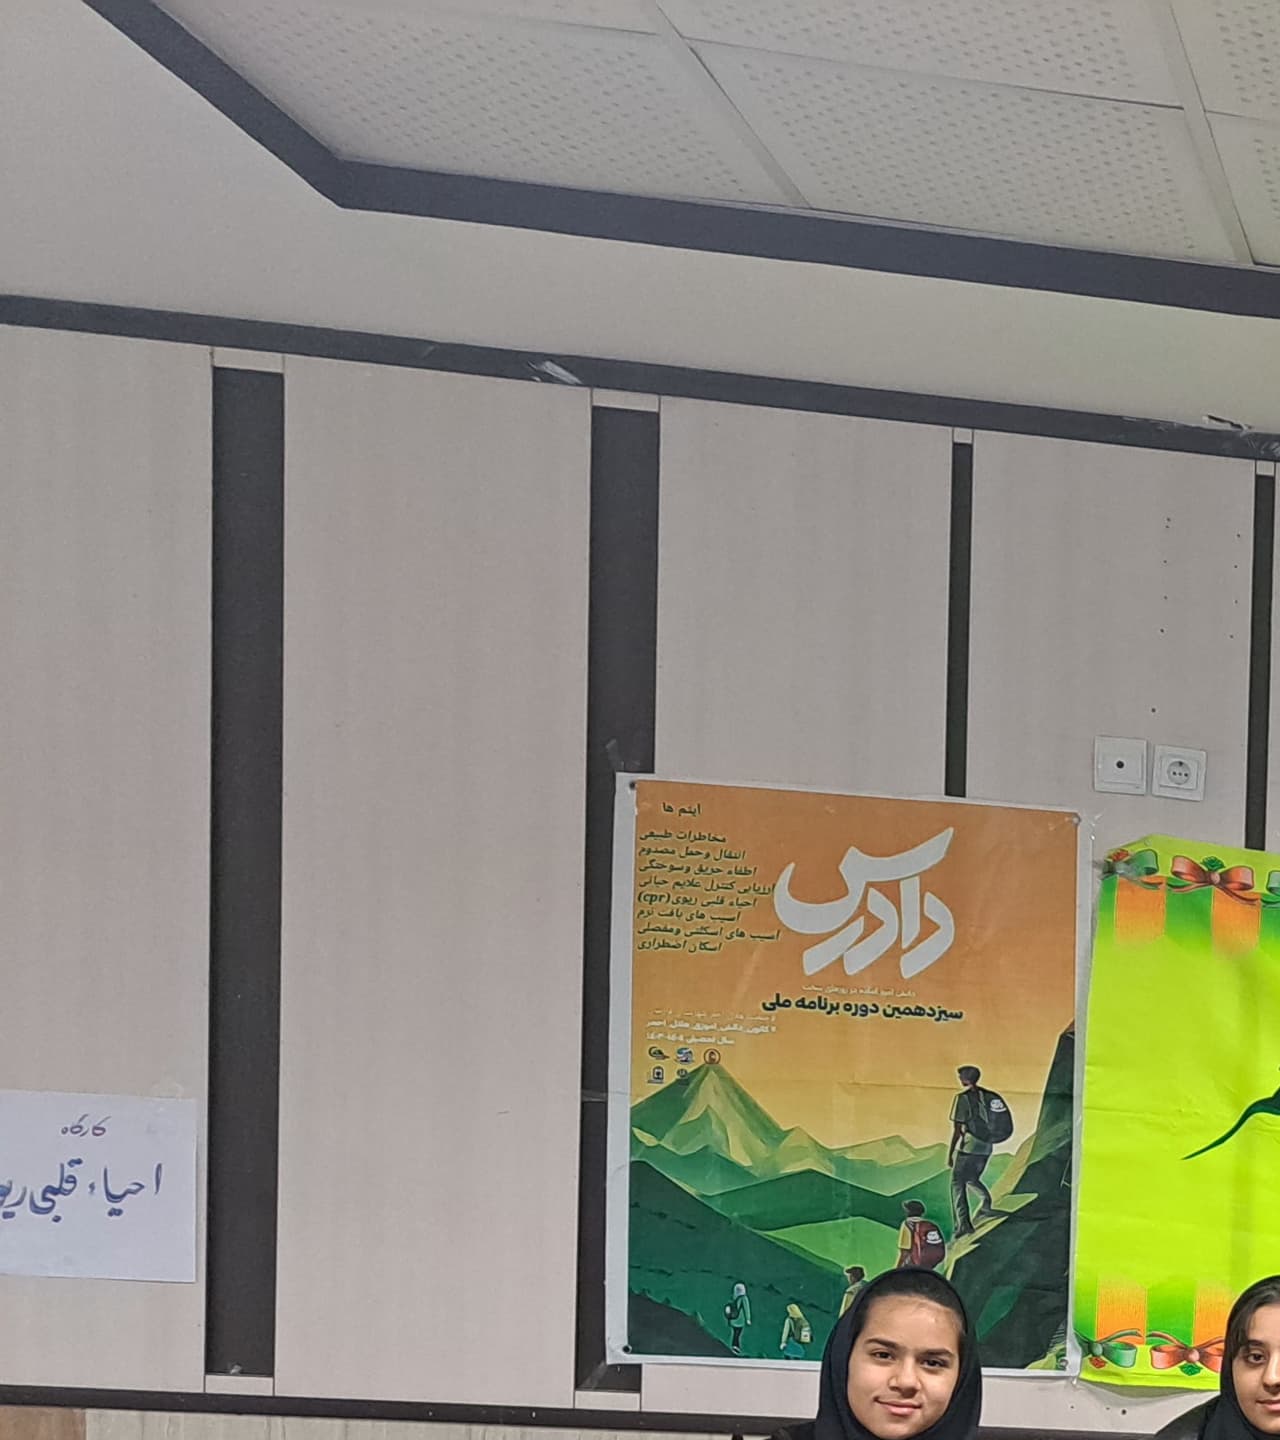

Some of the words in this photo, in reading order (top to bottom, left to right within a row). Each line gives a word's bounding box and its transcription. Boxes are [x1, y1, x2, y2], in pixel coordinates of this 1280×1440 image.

[761, 992, 792, 1012] ملی
[794, 995, 841, 1016] برنامه
[842, 1001, 880, 1017] دوره
[882, 1003, 964, 1022] سیزدهمین
